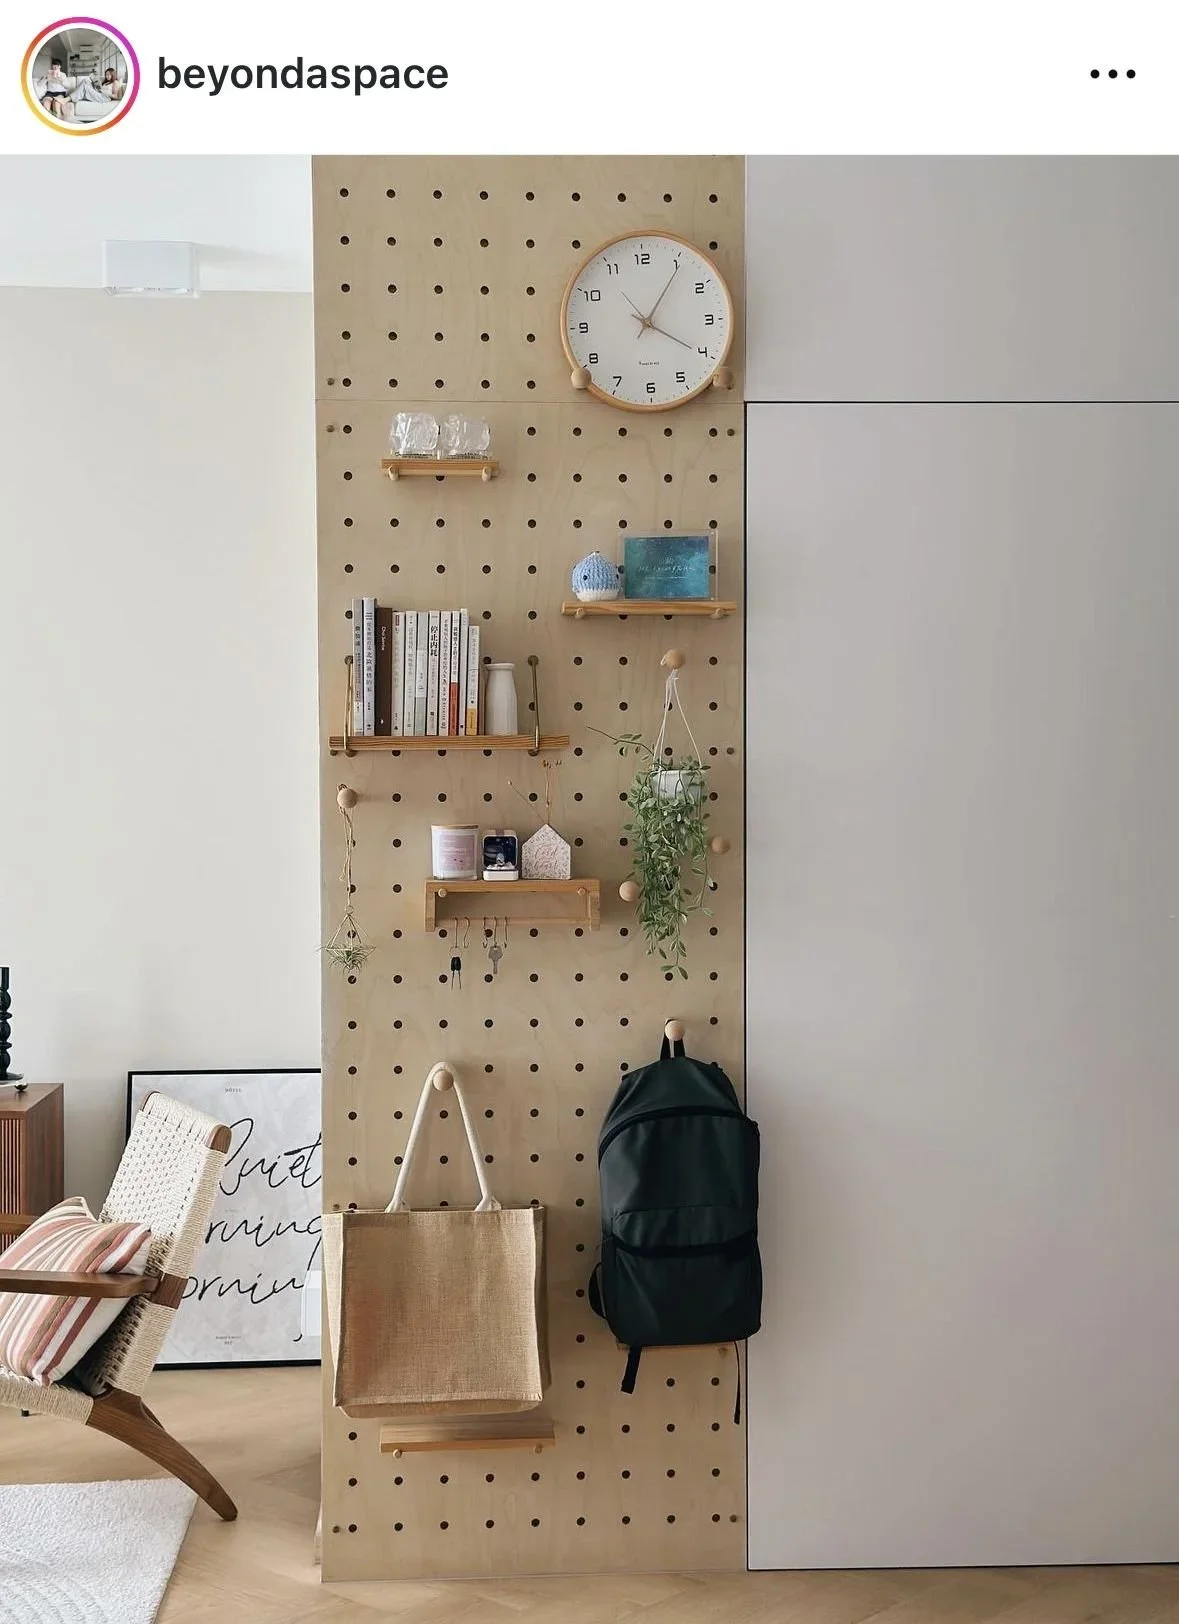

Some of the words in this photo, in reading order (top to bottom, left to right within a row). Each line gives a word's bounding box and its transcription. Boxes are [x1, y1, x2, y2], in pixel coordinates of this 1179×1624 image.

[634, 253, 651, 265] 12
[606, 263, 619, 275] 11
[694, 282, 705, 294] 2
[583, 289, 601, 302] 10
[704, 314, 714, 325] 3
[578, 322, 589, 333] 9
[697, 346, 708, 357] 4
[588, 352, 599, 364] 8
[612, 376, 622, 387] 7
[675, 371, 686, 383] 5
[646, 382, 656, 393] 6
